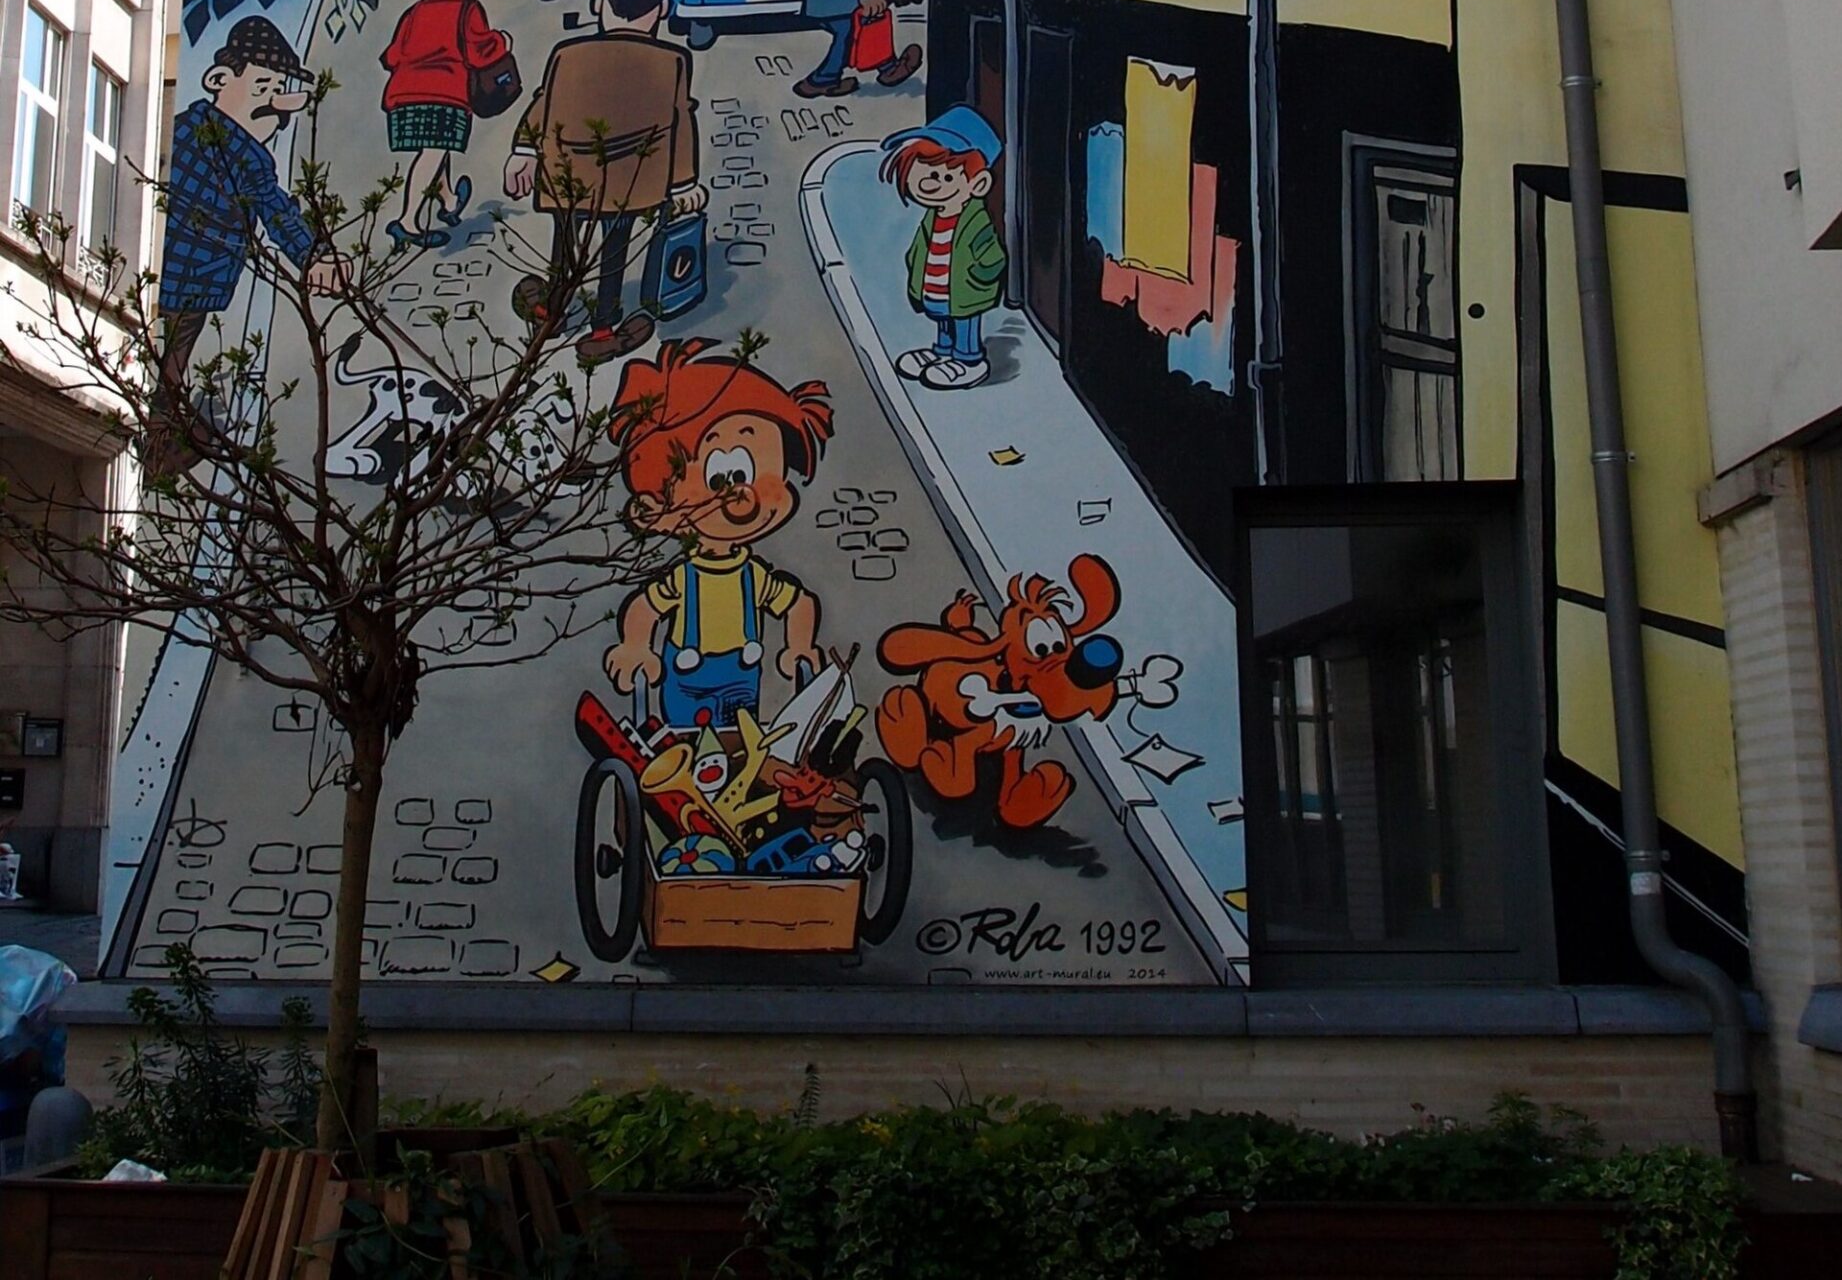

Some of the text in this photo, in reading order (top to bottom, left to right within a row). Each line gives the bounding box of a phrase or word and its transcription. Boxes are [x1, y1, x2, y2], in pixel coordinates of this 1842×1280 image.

[1080, 919, 1166, 956] 1992
[984, 968, 1167, 980] www.art-mural.eu 2014
